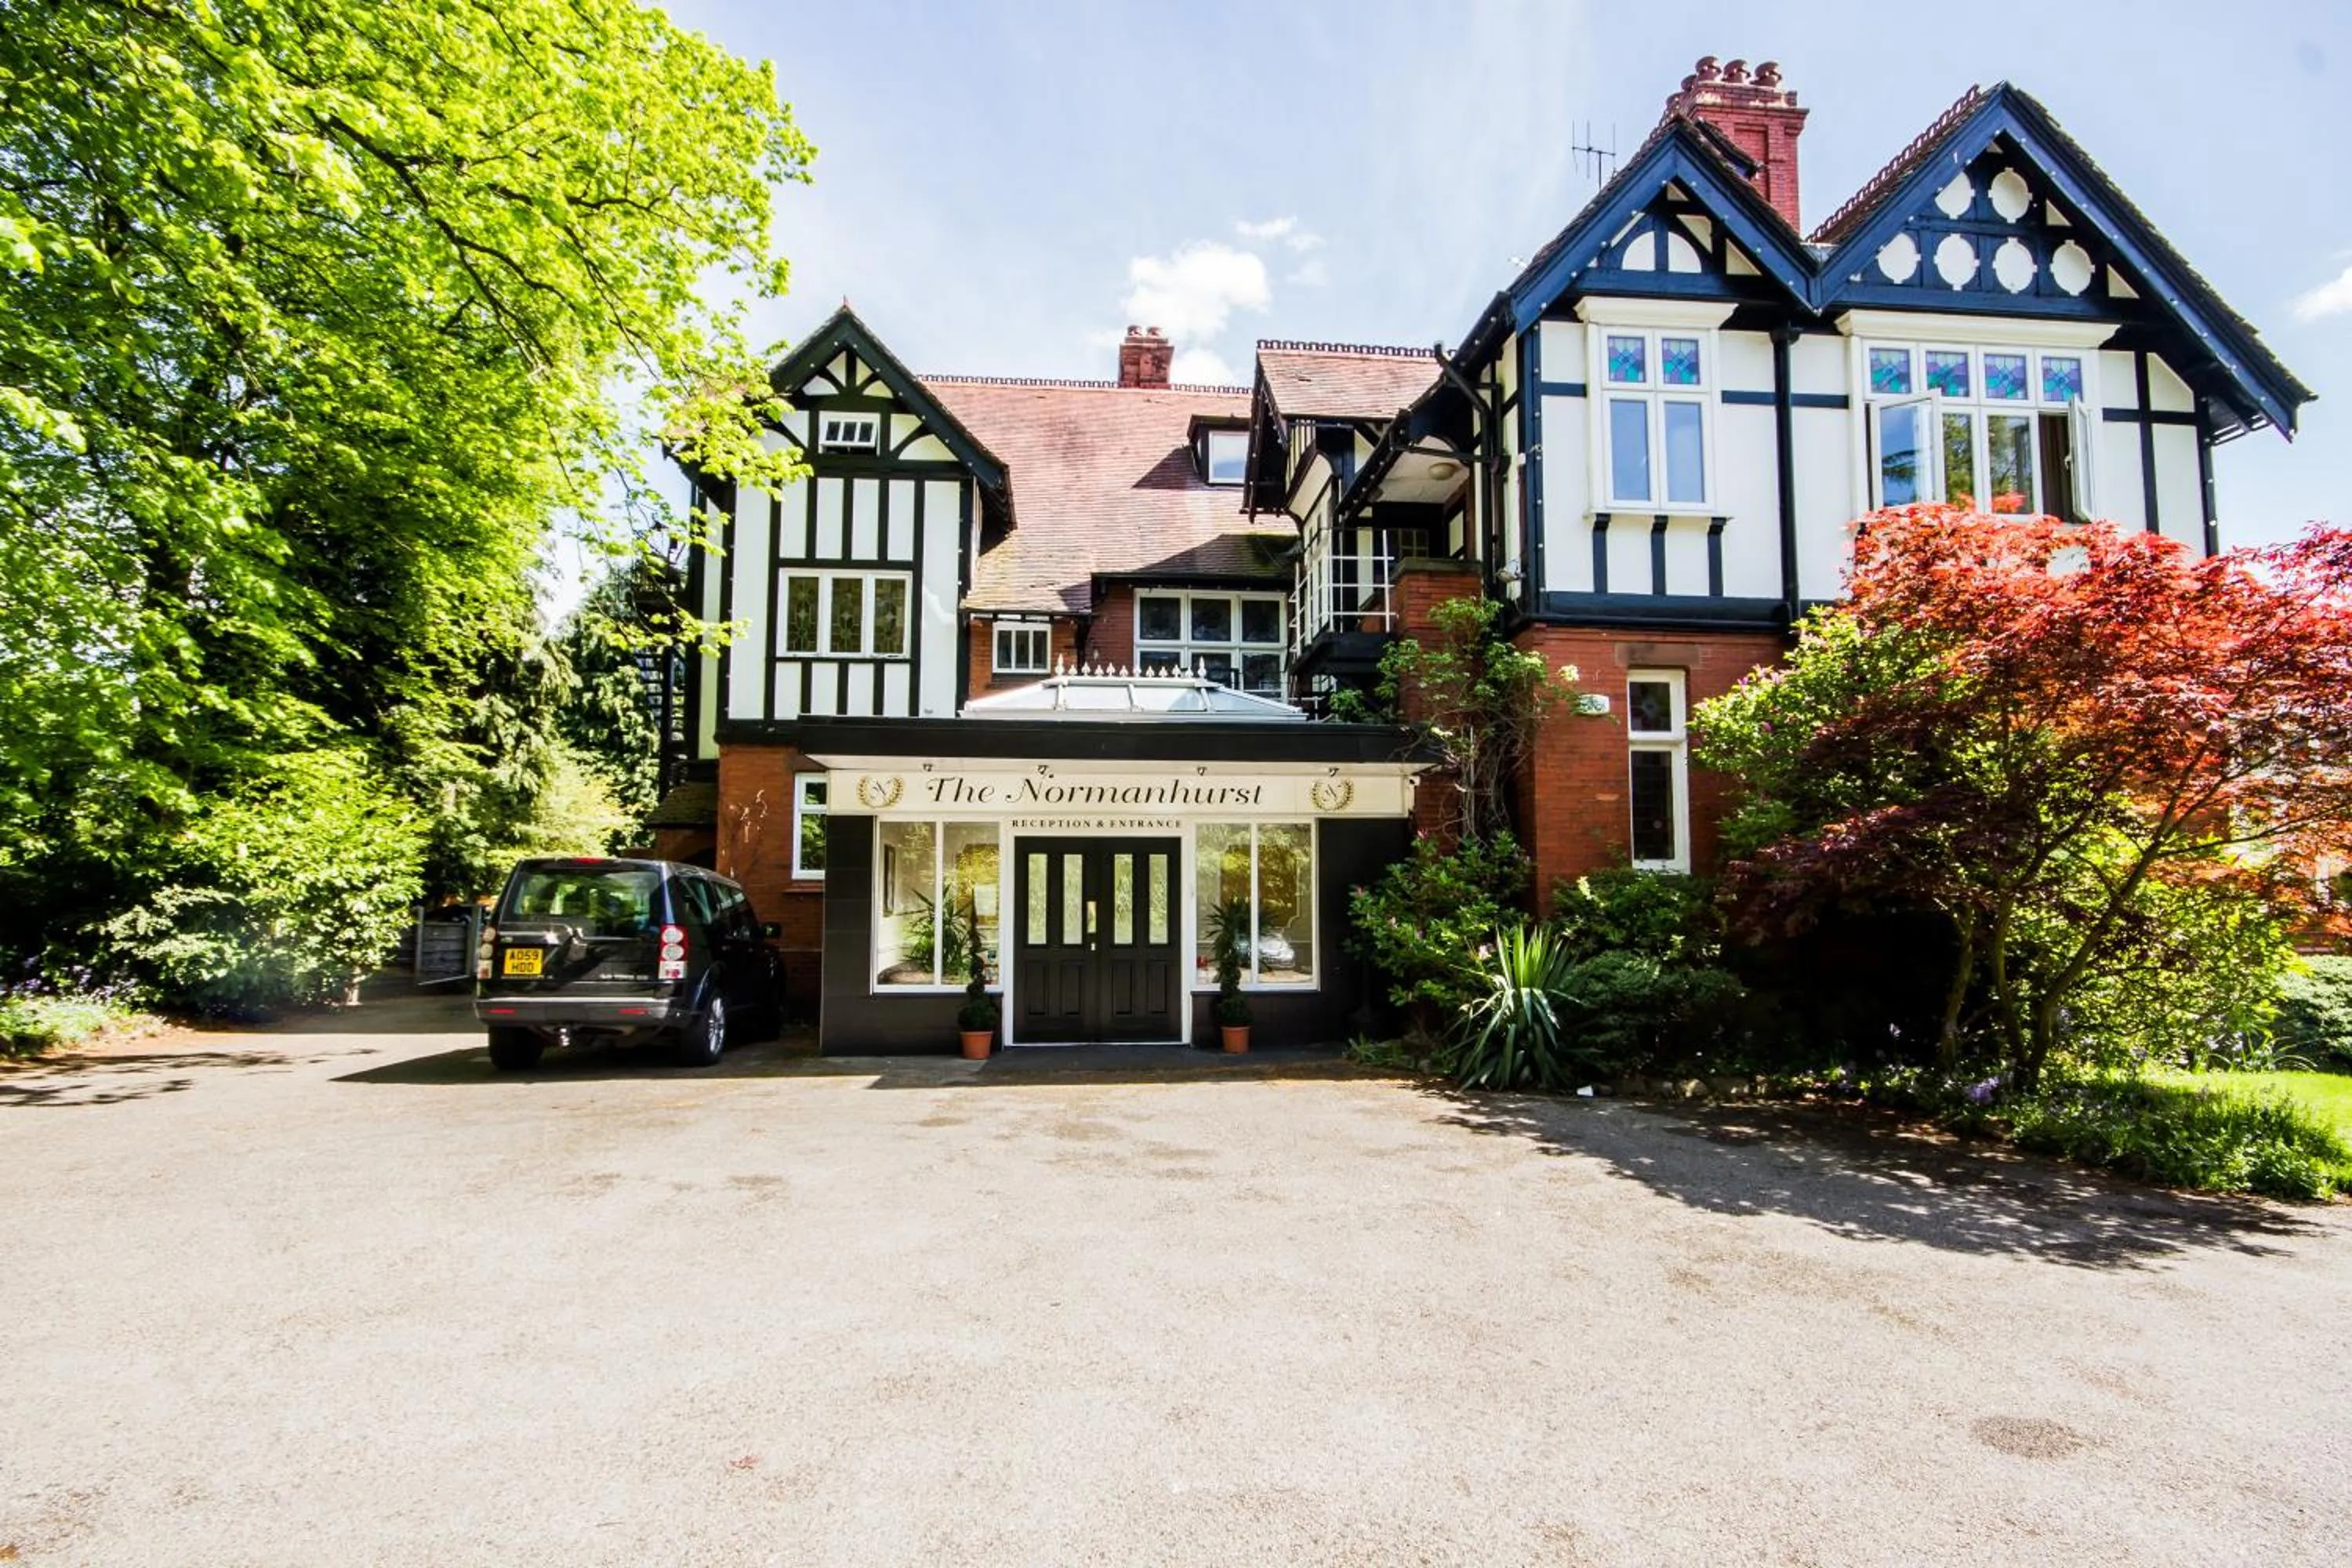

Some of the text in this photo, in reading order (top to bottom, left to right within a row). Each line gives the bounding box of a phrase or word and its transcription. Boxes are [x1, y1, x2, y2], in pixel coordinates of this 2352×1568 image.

[927, 777, 1261, 804] The Normanhurst
[1012, 819, 1182, 829] RECEPTION & ENTRANCE
